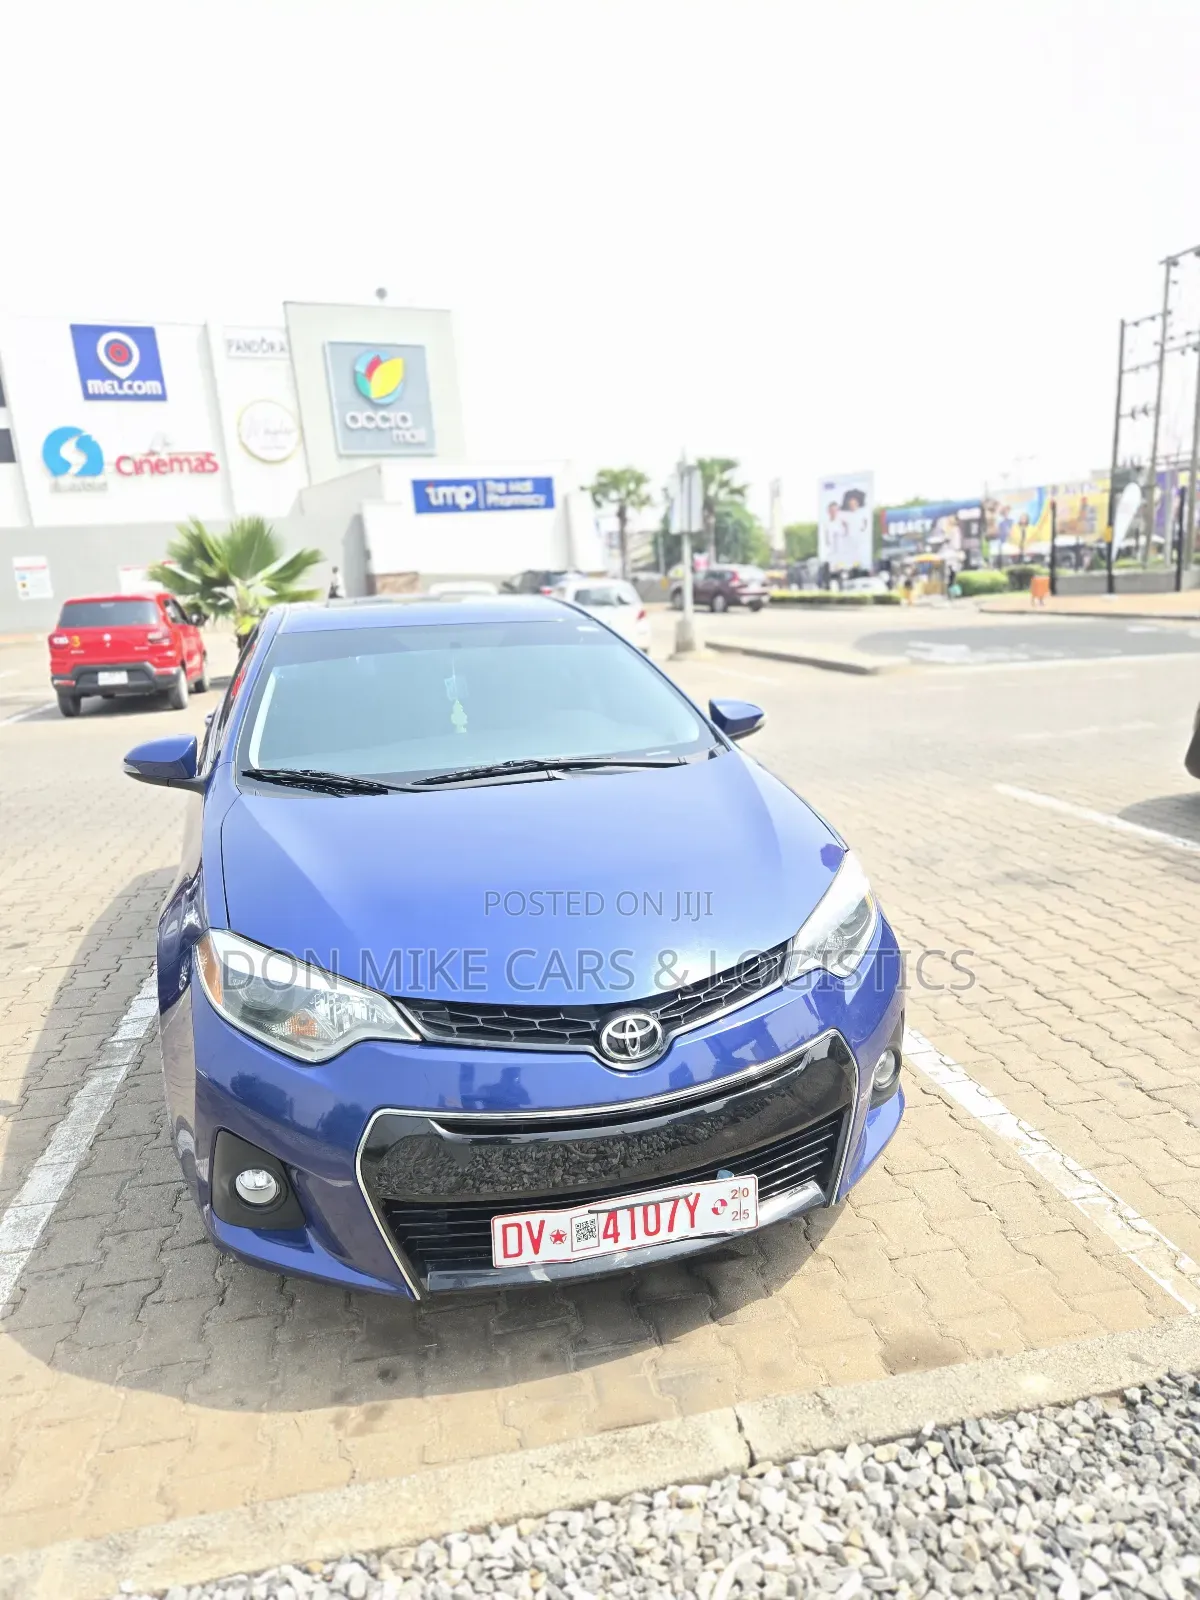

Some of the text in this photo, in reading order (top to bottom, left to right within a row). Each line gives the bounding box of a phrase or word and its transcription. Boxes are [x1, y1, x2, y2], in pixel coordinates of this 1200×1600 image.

[345, 411, 413, 429] accra
[502, 1192, 701, 1259] DV 4107Y
